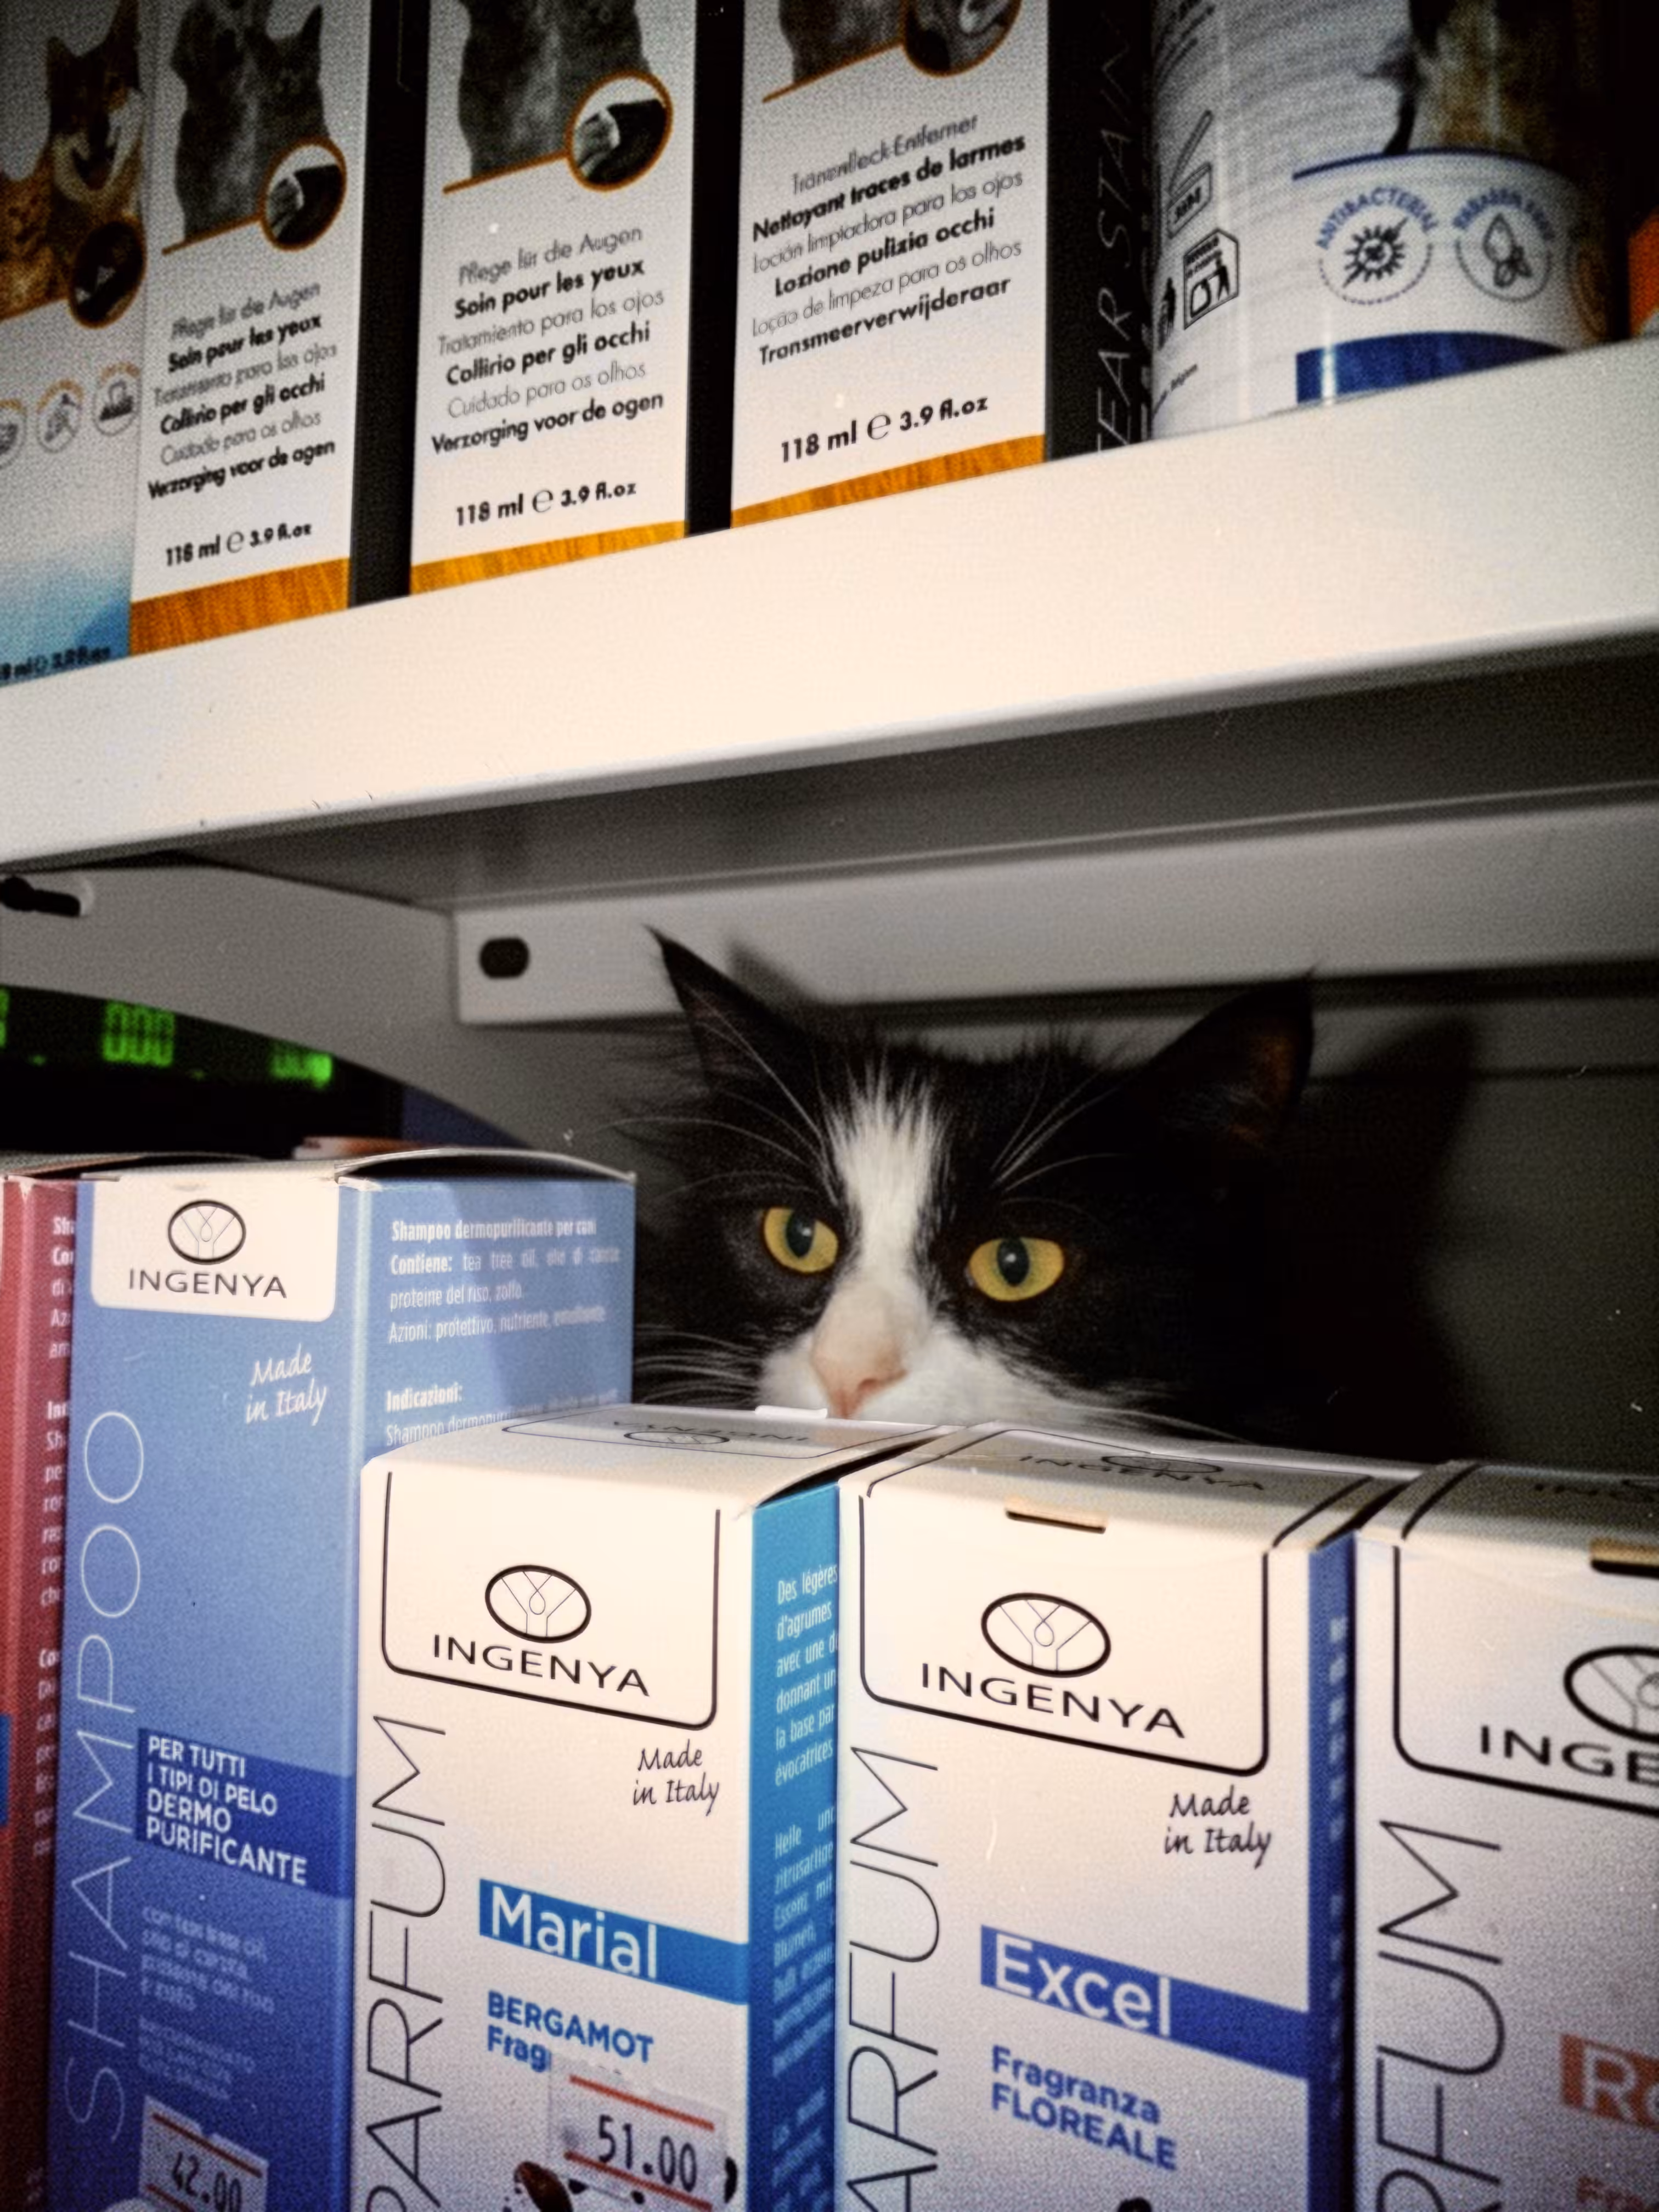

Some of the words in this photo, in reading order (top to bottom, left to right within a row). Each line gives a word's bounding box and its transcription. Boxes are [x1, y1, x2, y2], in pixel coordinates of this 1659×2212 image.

[851, 172, 911, 205] traces
[916, 156, 943, 181] de
[949, 136, 1026, 171] larmes
[902, 194, 944, 227] para
[951, 184, 976, 205] los
[983, 172, 1023, 198] ojos
[580, 228, 642, 254] Augen
[775, 258, 851, 297] Lozione
[857, 231, 929, 274] pulizia
[935, 207, 995, 242] occhi
[455, 291, 496, 319] Soin
[503, 281, 551, 313] pour
[557, 270, 584, 294] les
[590, 259, 645, 291] yeux
[803, 297, 823, 319] de
[829, 279, 893, 311] limpeza
[899, 264, 938, 294] para
[945, 256, 966, 274] os
[972, 241, 1022, 266] olhos
[541, 308, 583, 336] para
[623, 289, 664, 316] ojos
[169, 347, 202, 373] Soin
[206, 338, 244, 368] pour
[278, 315, 321, 344] yeux
[446, 353, 515, 385] Collirio
[522, 347, 555, 375] per
[562, 332, 587, 364] gli
[594, 320, 650, 351] occhi
[1097, 286, 1131, 452] EAR
[221, 399, 247, 425] per
[253, 383, 274, 415] gli
[280, 372, 325, 402] occhi
[448, 385, 520, 418] Cuidado
[526, 379, 565, 407] para
[572, 375, 591, 391] os
[597, 360, 646, 385] olhos
[432, 419, 528, 454] Verzorging
[534, 411, 579, 432] voor
[582, 397, 606, 422] de
[612, 393, 663, 420] ogen
[781, 433, 820, 462] 118
[827, 420, 857, 450] ml
[899, 405, 933, 432] 3.9
[292, 441, 335, 465] ogen
[456, 501, 490, 526] 118
[498, 493, 524, 519] ml
[561, 485, 590, 506] 3.9
[166, 543, 193, 566] 118
[199, 533, 221, 559] ml
[392, 1220, 451, 1243] Shampoo
[129, 1268, 287, 1299] INGENYA
[391, 1253, 453, 1275] Contiene:
[463, 1254, 481, 1271] tea
[390, 1286, 442, 1312] proteine
[446, 1284, 464, 1305] del
[389, 1319, 432, 1344] Azioni:
[250, 1342, 312, 1387] Made
[245, 1394, 269, 1424] in
[275, 1378, 328, 1426] Italy
[386, 1381, 464, 1413] Indicazioni:
[777, 1580, 797, 1605] Des
[802, 1564, 838, 1595] légères
[777, 1601, 832, 1641] d'agrumes
[433, 1634, 650, 1696] INGENYA
[777, 1650, 800, 1678] avec
[805, 1639, 825, 1664] une
[776, 1672, 820, 1714] donnant
[922, 1662, 1186, 1739] INGENYA
[148, 1735, 185, 1762] PER
[190, 1745, 246, 1778] TUTTI
[637, 1738, 703, 1771] Made
[776, 1726, 786, 1751] la
[791, 1714, 814, 1742] base
[65, 1410, 144, 2144] SHAMPOO
[147, 1762, 154, 1783] I
[159, 1765, 193, 1792] TIPI
[199, 1778, 219, 1801] DI
[224, 1784, 278, 1816] PELO
[633, 1779, 657, 1806] in
[665, 1771, 720, 1816] Italy
[1169, 1784, 1251, 1818] Made
[146, 1788, 232, 1833] DERMO
[146, 1816, 308, 1886] PURIFICANTE
[1164, 1826, 1194, 1855] in
[1205, 1820, 1272, 1870] Italy
[492, 1886, 657, 1979] Marial
[994, 1932, 1171, 2038] Excel
[487, 1990, 654, 2063] BERGAMOT
[991, 2044, 1162, 2124] Fragranza
[991, 2083, 1178, 2171] FLOREALE
[599, 2115, 696, 2192] 51.00
[171, 2151, 242, 2212] 42.00
